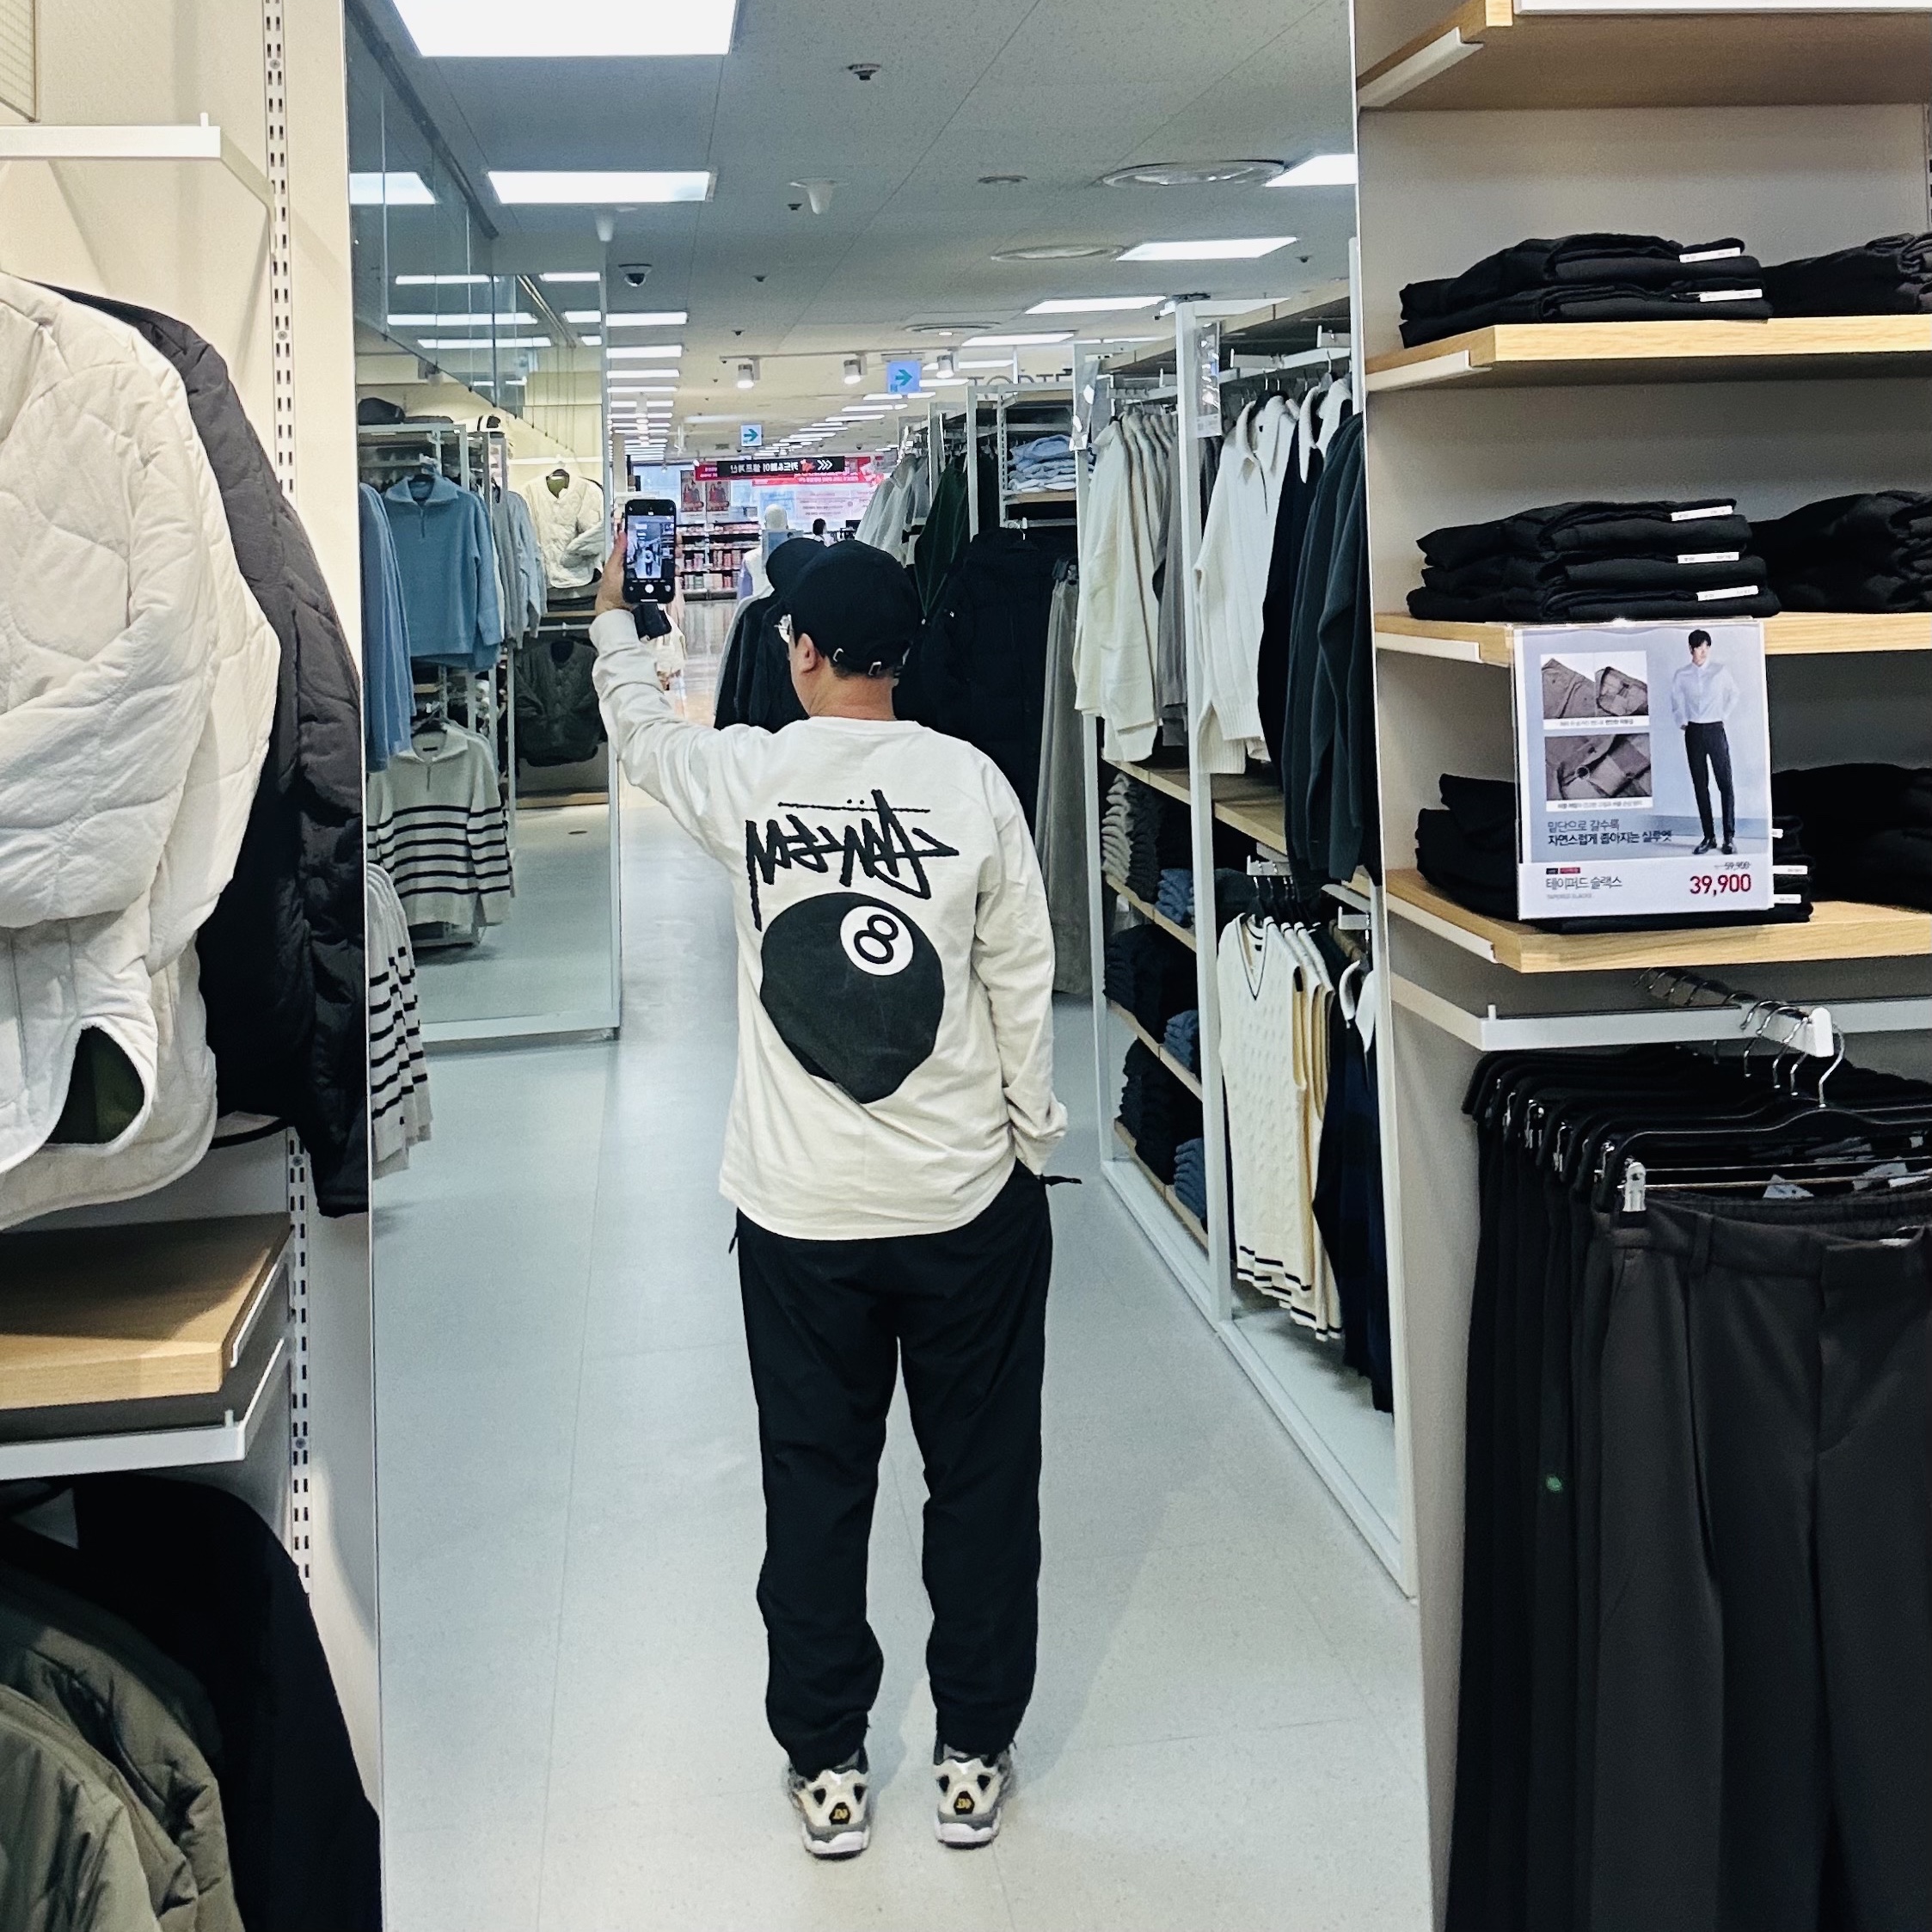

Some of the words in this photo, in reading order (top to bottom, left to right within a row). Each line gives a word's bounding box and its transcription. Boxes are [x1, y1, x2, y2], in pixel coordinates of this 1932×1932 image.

[1548, 820, 1587, 833] 밑단으로
[1590, 819, 1620, 832] 갈수록
[1548, 833, 1598, 846] 자연스럽게
[1600, 831, 1641, 844] 좁아지는
[1641, 830, 1672, 843] 실루엣
[1546, 877, 1590, 890] 테이퍼드
[1591, 876, 1622, 890] 슬랙스
[1690, 873, 1751, 897] 39,900
